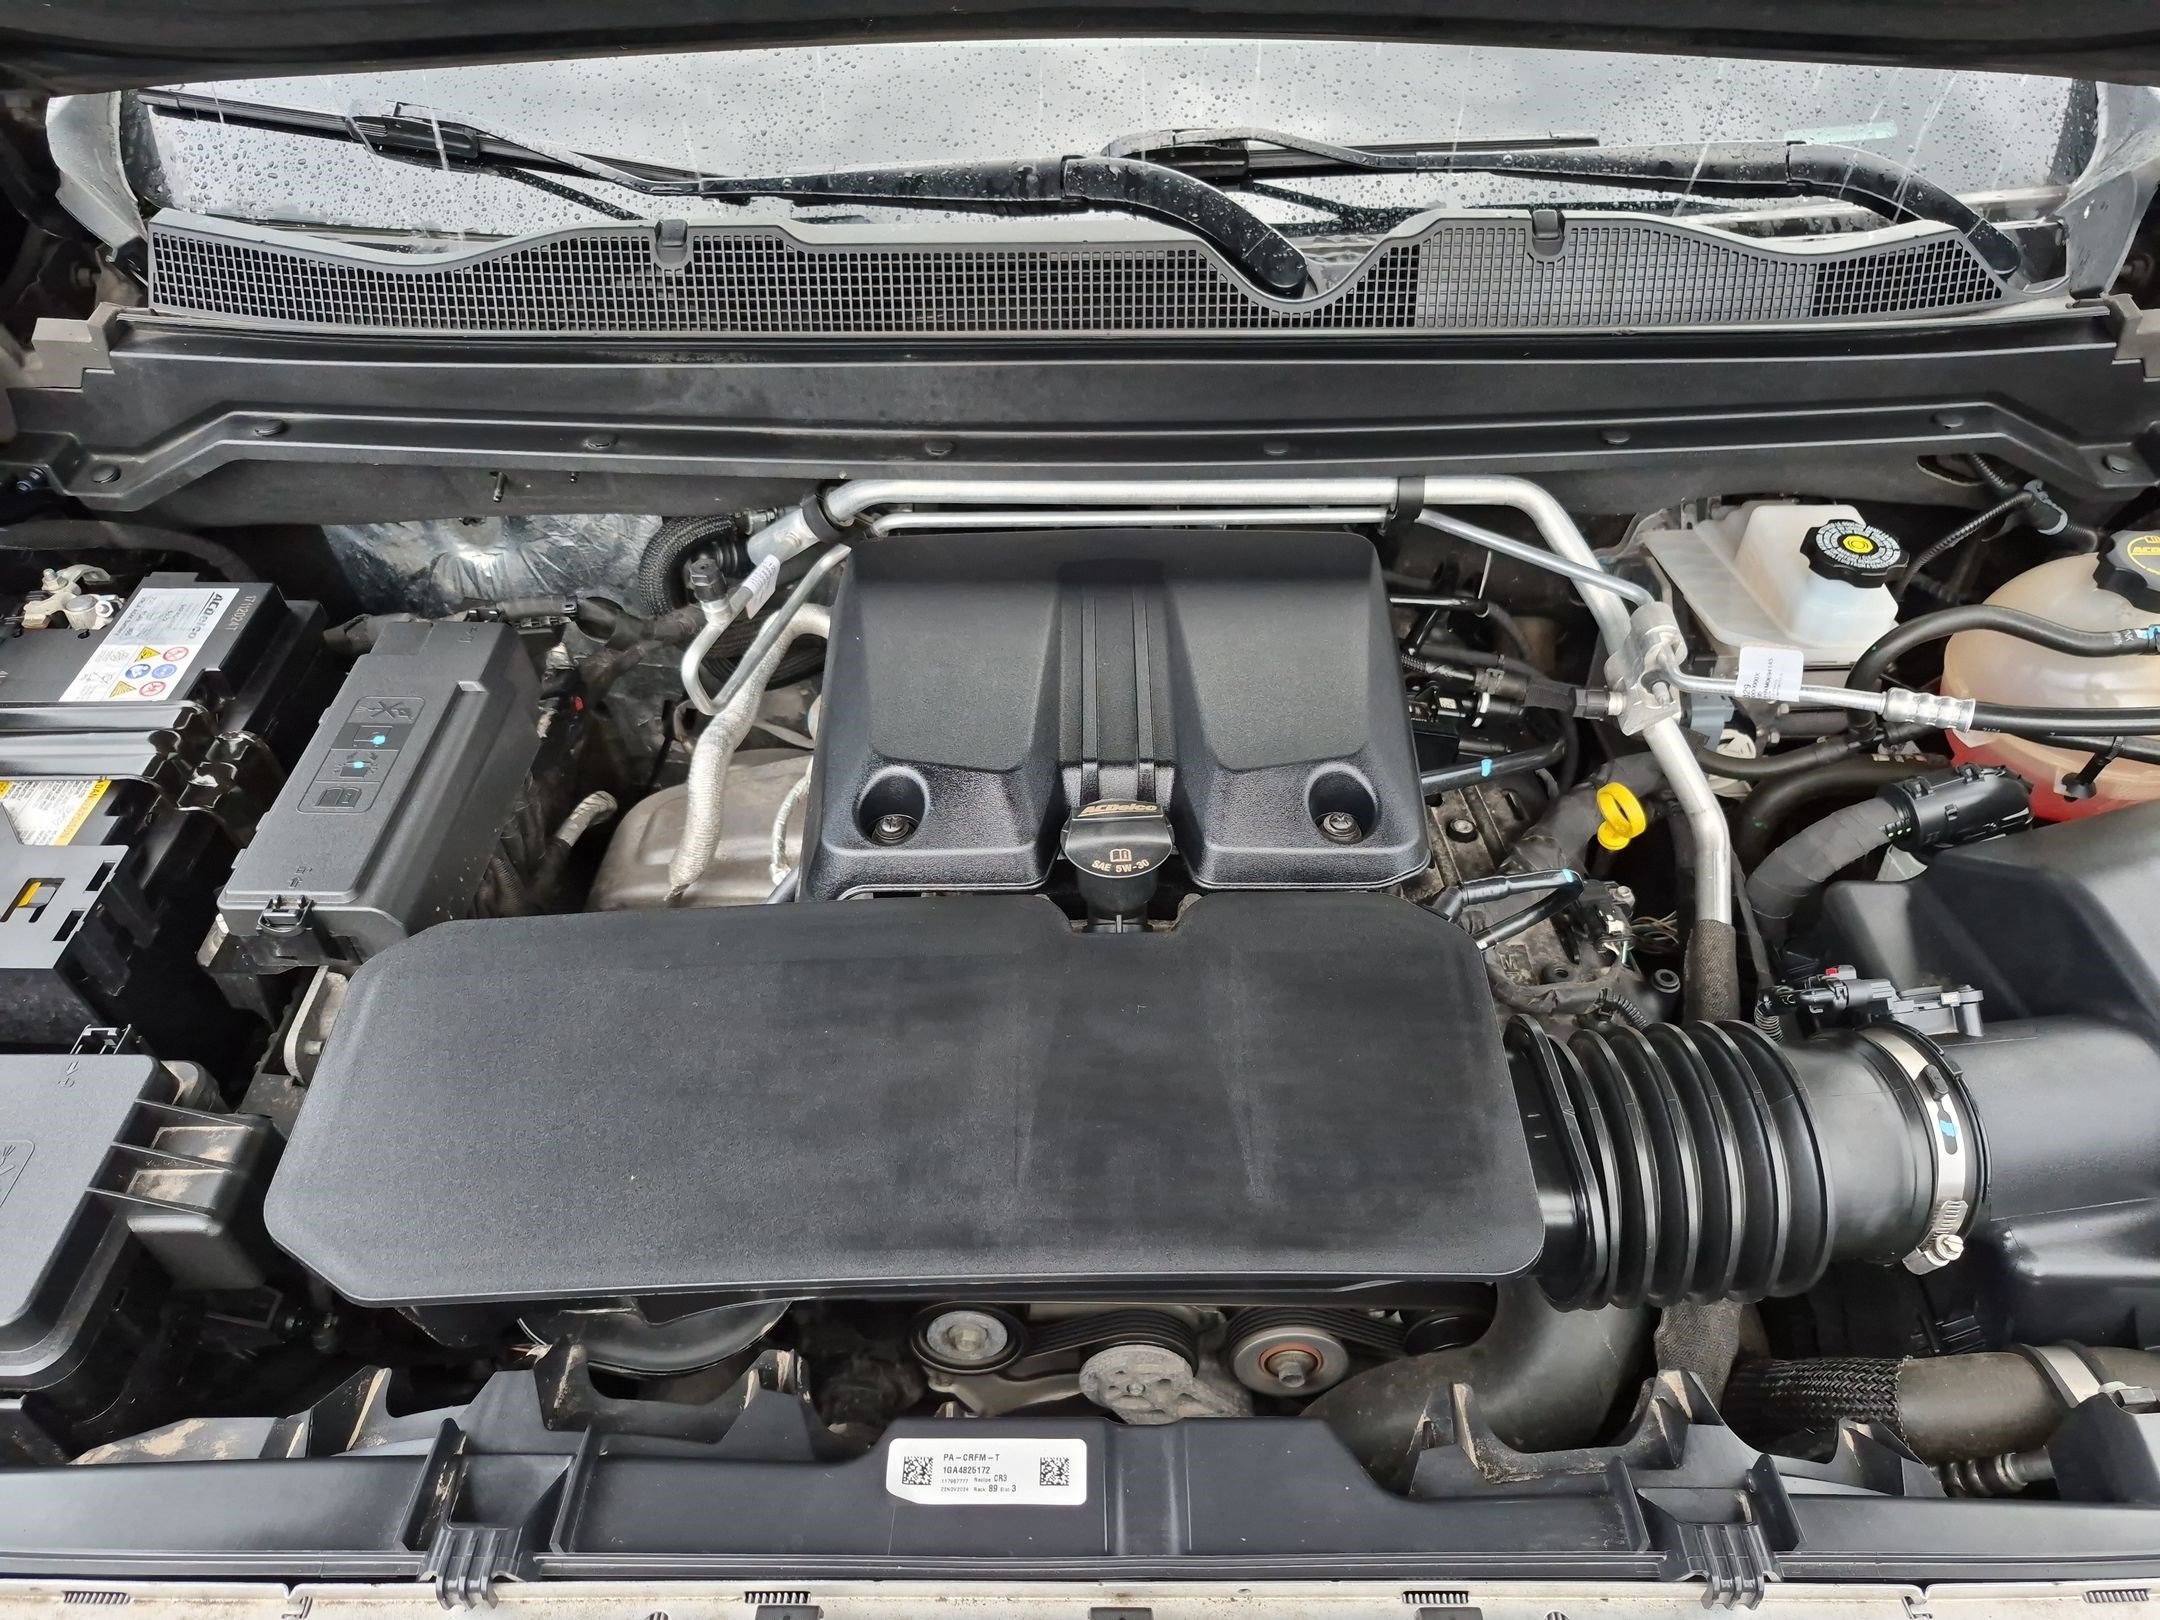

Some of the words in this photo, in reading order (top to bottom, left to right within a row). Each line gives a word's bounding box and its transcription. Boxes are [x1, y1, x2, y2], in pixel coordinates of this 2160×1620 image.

[188, 593, 224, 639] ACDelco
[1078, 803, 1158, 817] ACDelco
[1091, 860, 1111, 872] SAE
[1115, 859, 1150, 873] 5W-30
[943, 1466, 991, 1474] 1GA4825172
[993, 1474, 1008, 1482] CR3
[988, 1484, 998, 1493] 89
[1011, 1484, 1017, 1493] 3
